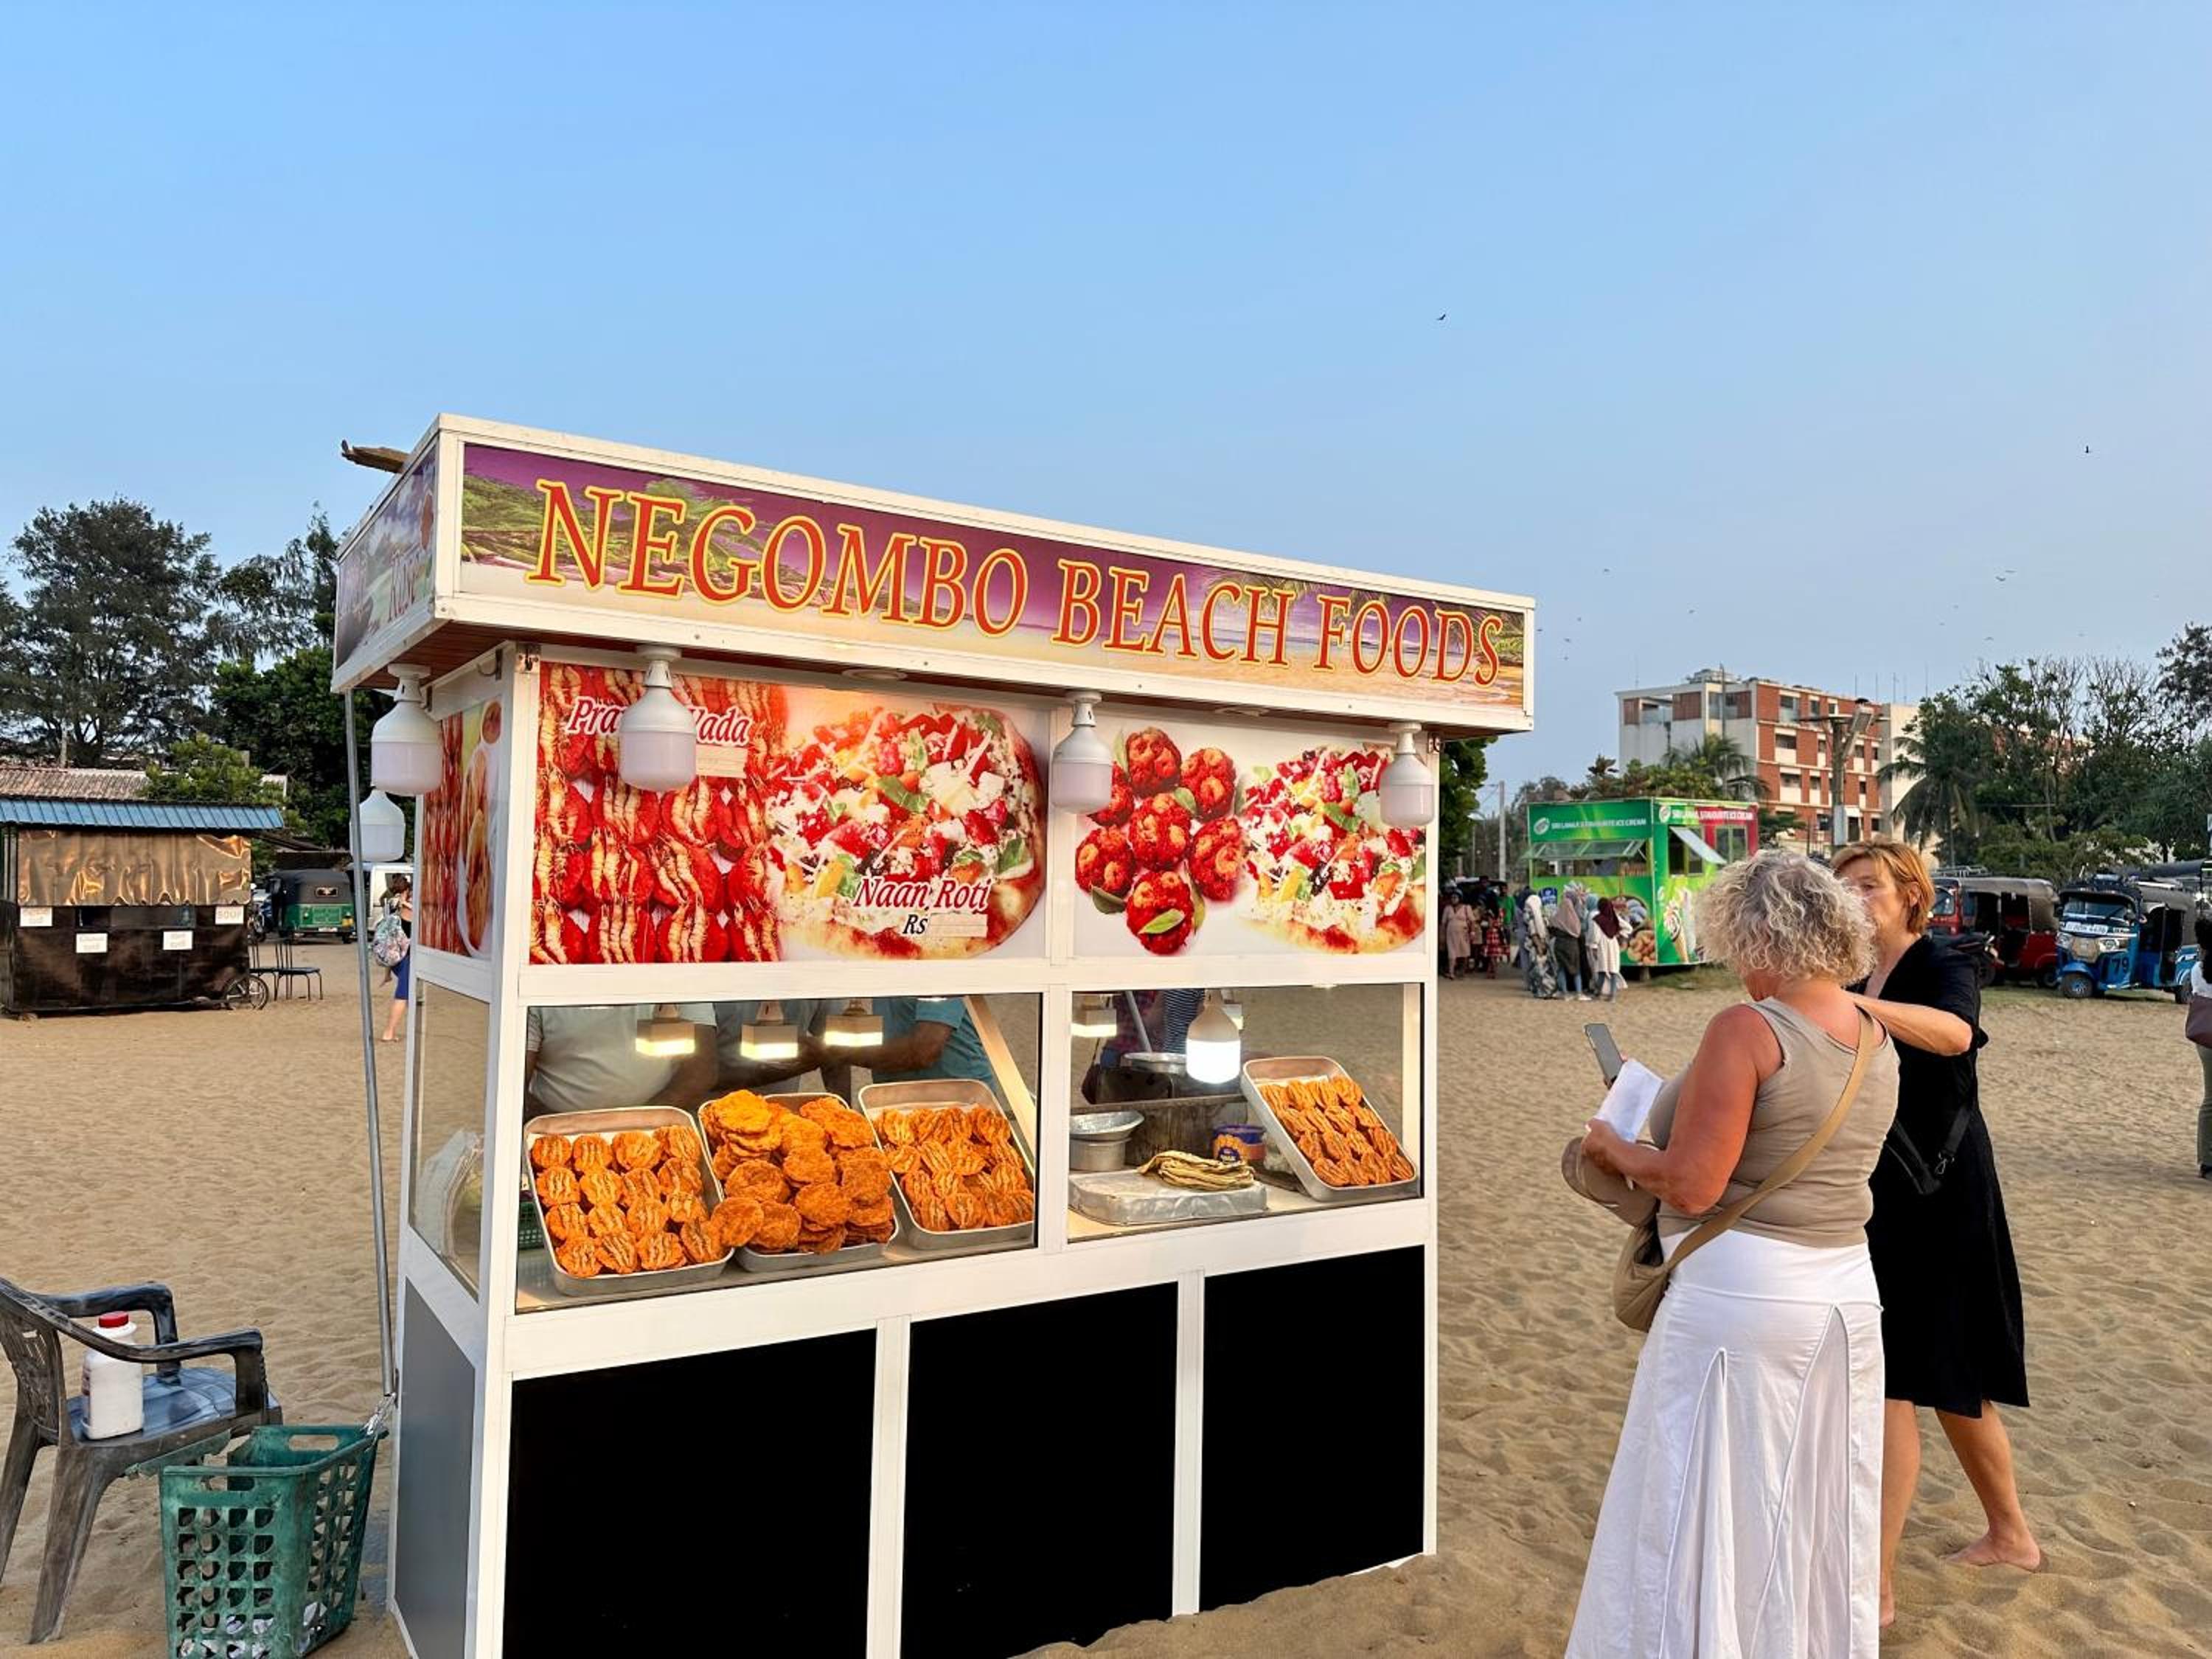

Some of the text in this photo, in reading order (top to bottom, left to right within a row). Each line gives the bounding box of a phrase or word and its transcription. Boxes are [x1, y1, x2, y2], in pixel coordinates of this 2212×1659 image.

[525, 479, 1028, 636] NEGOMBO
[1051, 558, 1296, 669] BEACH
[1312, 594, 1503, 687] FOODS
[566, 697, 629, 734] Pra
[853, 877, 992, 911] Naan Roti
[902, 913, 928, 935] Rs
[2112, 958, 2129, 973] 79
